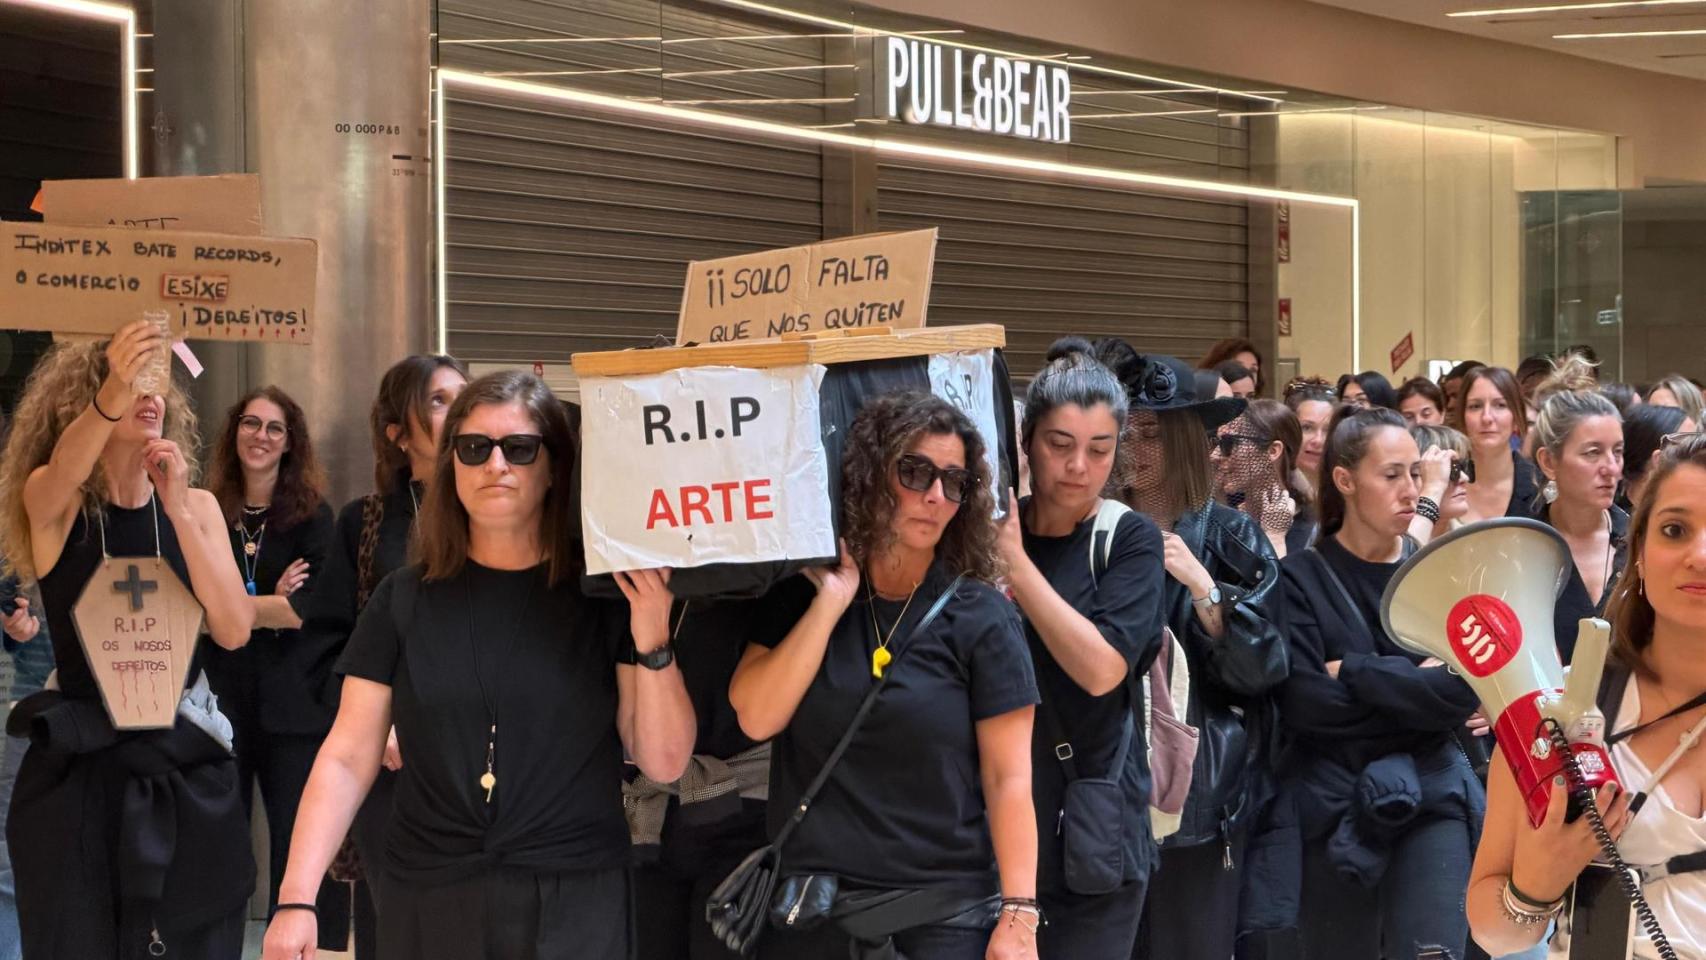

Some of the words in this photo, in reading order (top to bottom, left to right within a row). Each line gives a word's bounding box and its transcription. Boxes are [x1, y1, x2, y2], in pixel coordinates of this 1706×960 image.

[887, 36, 1071, 142] PULL&BEAR
[133, 241, 176, 258] BATE
[194, 246, 281, 267] RECORDS,
[15, 269, 27, 284] O
[818, 254, 889, 287] FALTA
[709, 320, 751, 343] QUE
[767, 312, 810, 338] NOS
[643, 396, 761, 446] R.I.P
[646, 479, 773, 530] ARTE
[114, 617, 156, 632] R.I.P
[102, 640, 119, 652] OS
